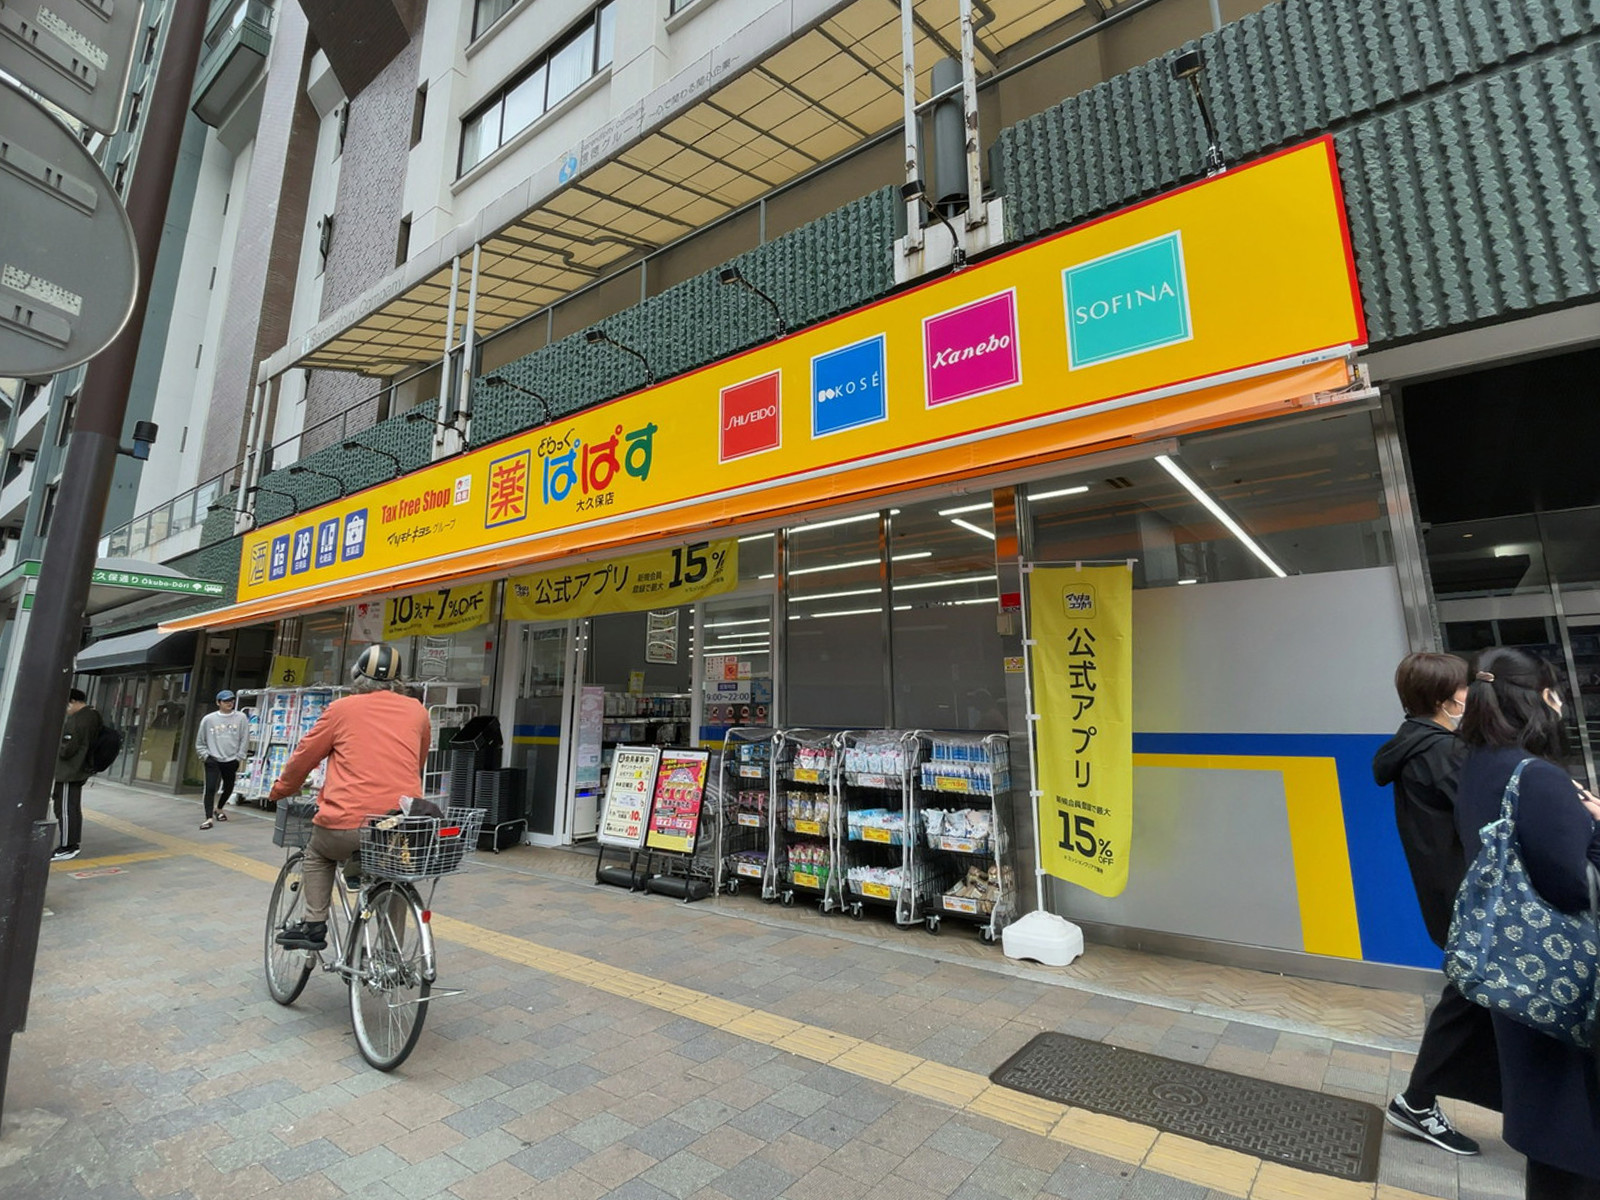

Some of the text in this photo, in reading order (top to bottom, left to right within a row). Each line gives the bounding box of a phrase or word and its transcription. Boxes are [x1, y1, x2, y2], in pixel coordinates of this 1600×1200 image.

[1075, 281, 1175, 325] SOFINA
[932, 333, 1011, 370] Kanebo
[835, 370, 879, 398] KOSÉ
[725, 405, 776, 431] SHISEIDO
[542, 422, 659, 505] ぱぱす
[381, 488, 451, 525] Tax Free Shop
[490, 459, 526, 521] 薬
[576, 492, 615, 512] 大久保店
[92, 571, 139, 584] 久保通り
[535, 563, 629, 605] 公式アプリ
[283, 668, 296, 683] お
[1067, 627, 1097, 788] 公式アプリ
[637, 781, 644, 792] 3
